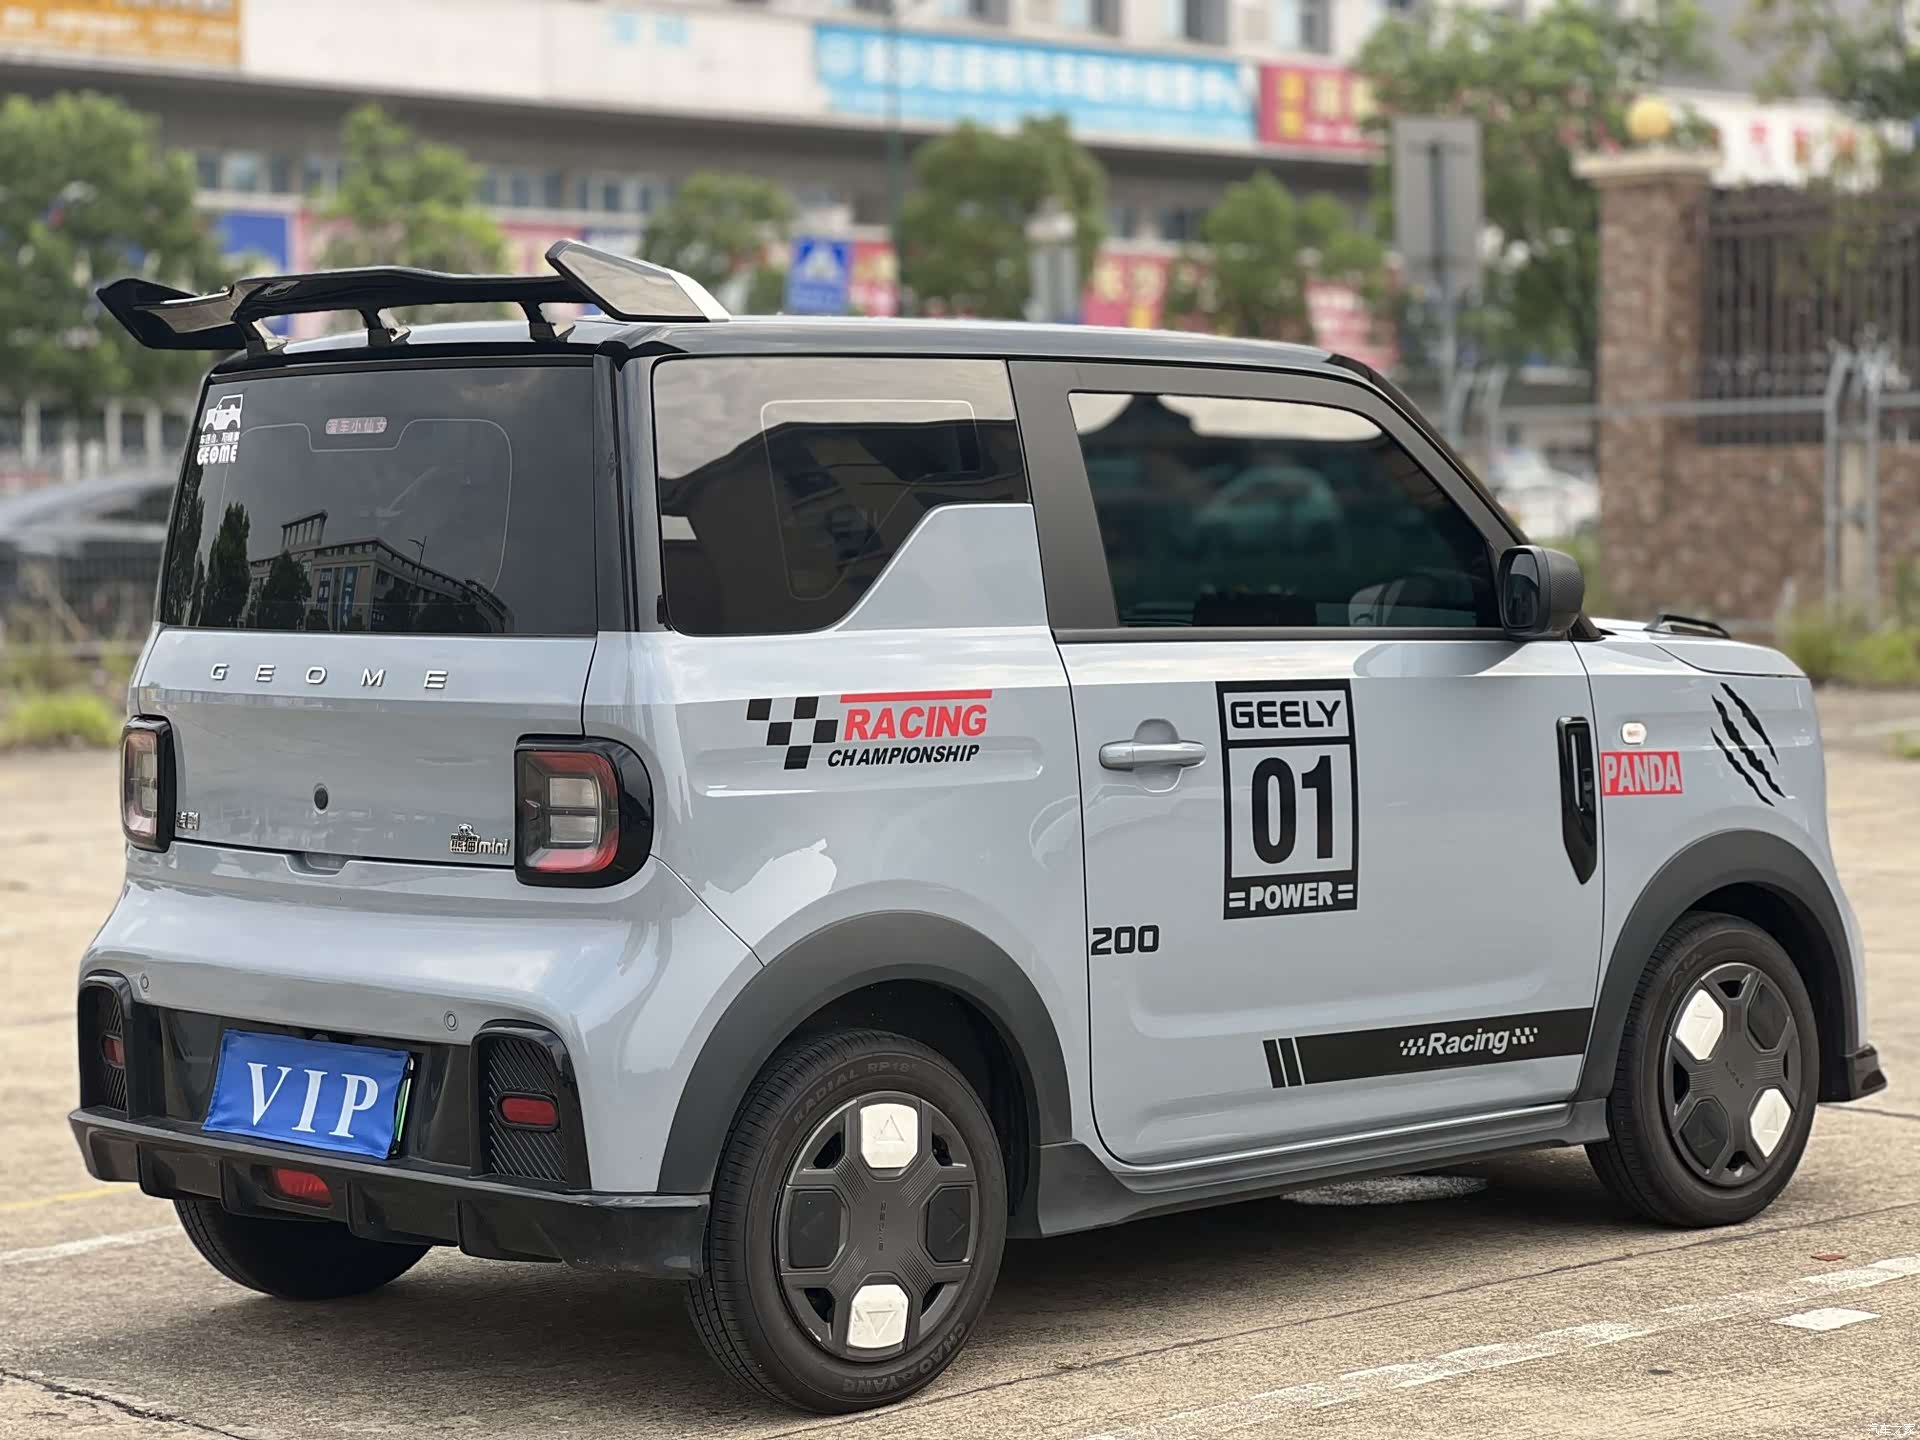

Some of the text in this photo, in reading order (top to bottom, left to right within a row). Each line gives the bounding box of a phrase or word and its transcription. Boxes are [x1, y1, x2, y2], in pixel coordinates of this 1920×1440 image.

[196, 444, 238, 465] GEOME
[210, 663, 448, 690] GEOME
[844, 704, 987, 741] RACING
[1230, 700, 1341, 728] GEELY
[827, 744, 980, 767] CHAMPIONSHIP
[1603, 754, 1681, 793] PANDA
[1251, 755, 1333, 864] 01
[1090, 924, 1160, 956] 200
[1427, 1029, 1509, 1056] Racing
[247, 1062, 379, 1138] VIP
